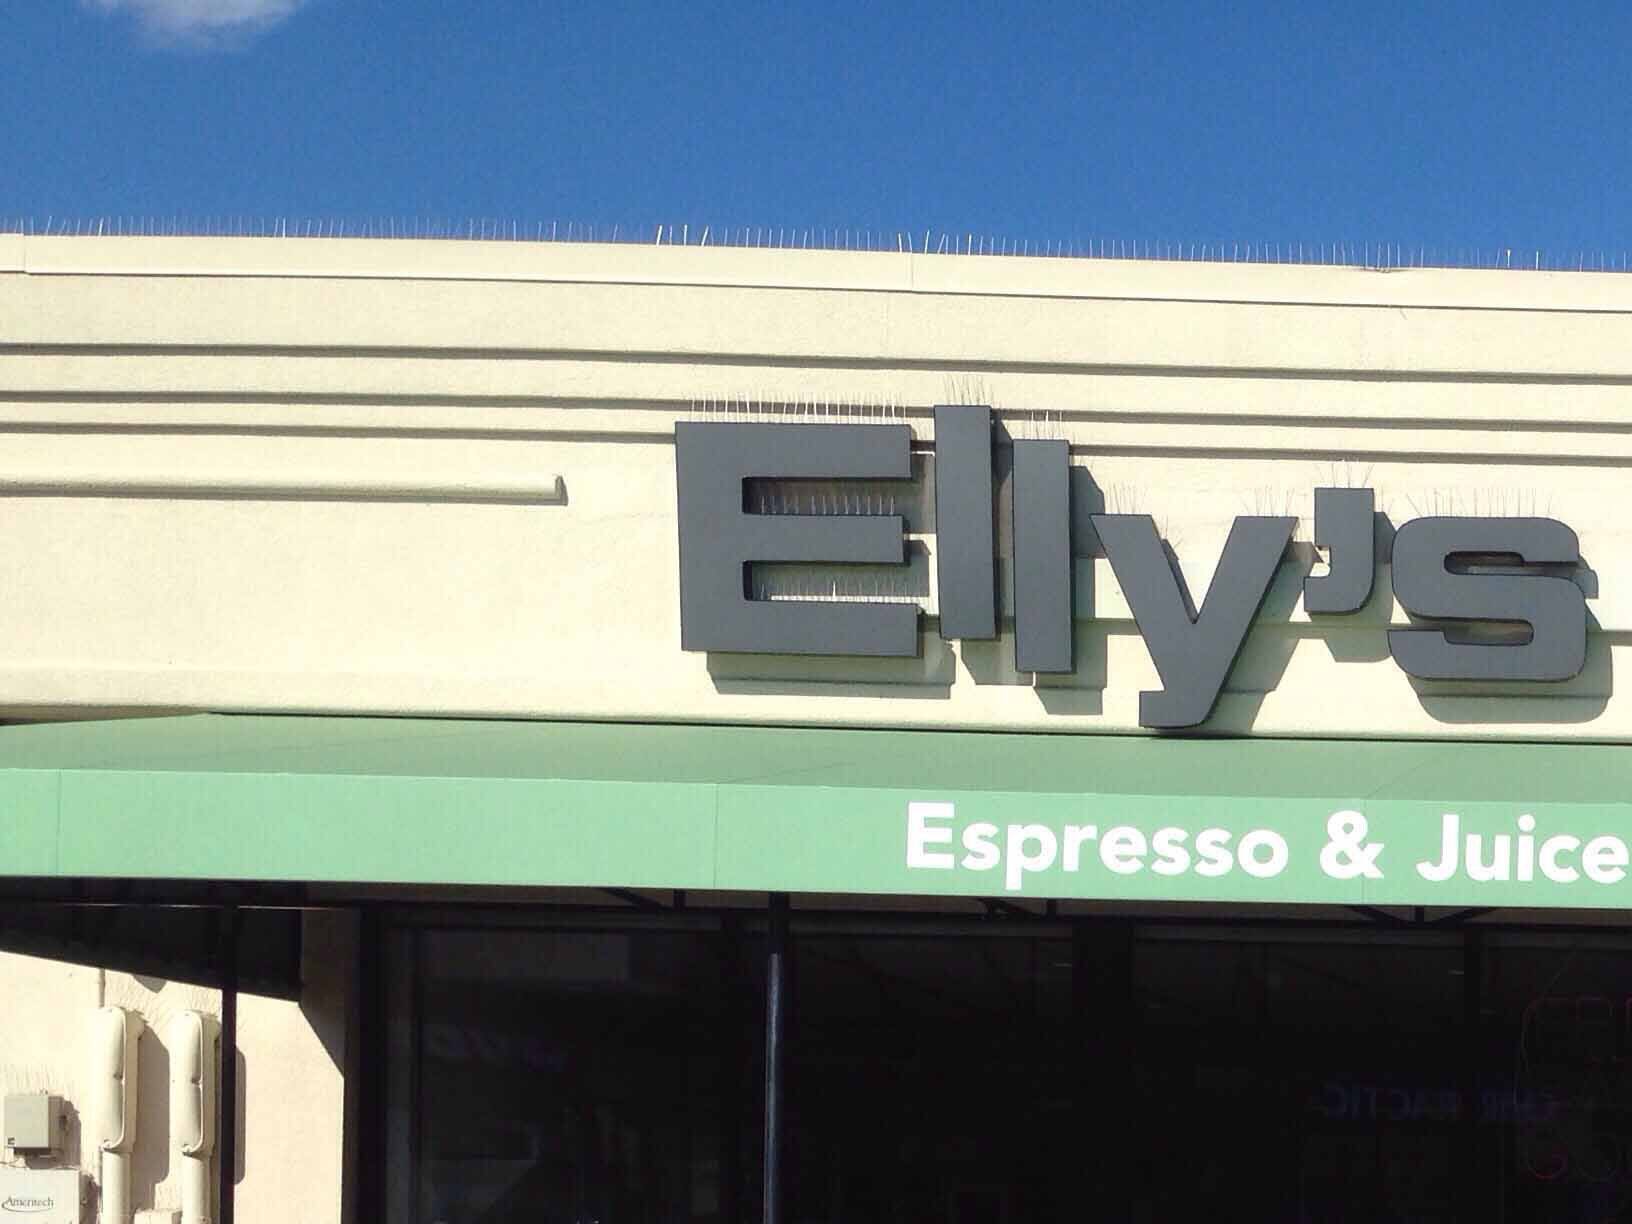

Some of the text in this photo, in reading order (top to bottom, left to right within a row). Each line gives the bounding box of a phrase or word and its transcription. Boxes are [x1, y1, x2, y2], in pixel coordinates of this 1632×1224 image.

[675, 405, 1587, 728] Elly's
[906, 802, 1289, 890] Espresso
[1319, 810, 1385, 879] &
[1416, 814, 1629, 885] Juice
